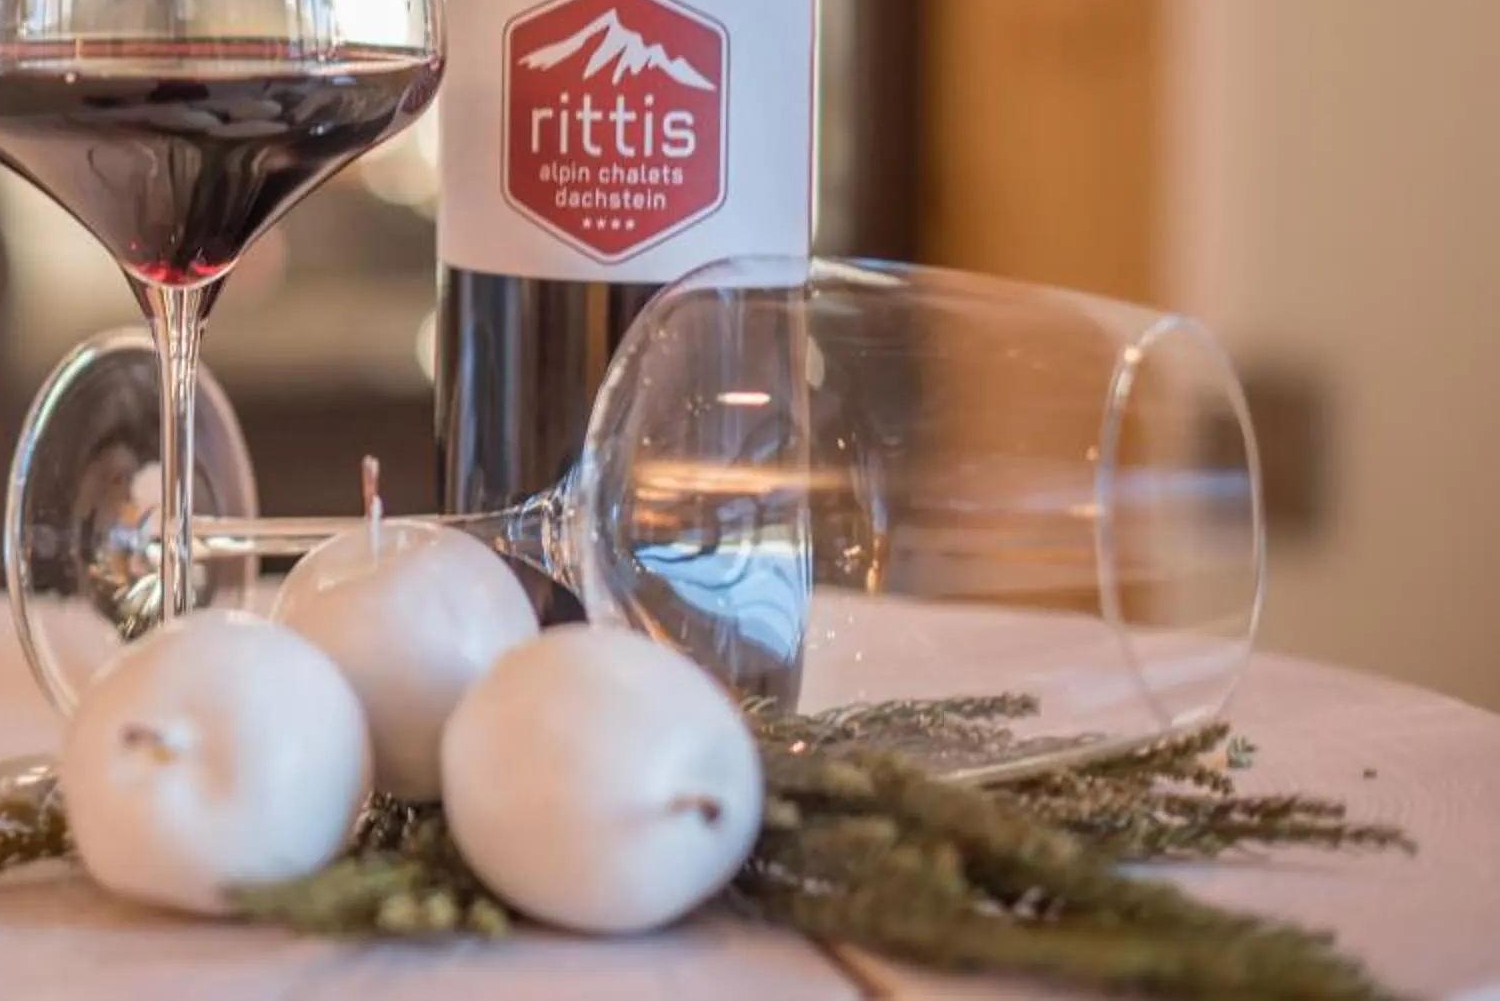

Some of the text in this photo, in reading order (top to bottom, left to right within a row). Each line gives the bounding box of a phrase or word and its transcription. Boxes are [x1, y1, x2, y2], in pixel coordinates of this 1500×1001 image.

[531, 92, 697, 157] rittis
[539, 162, 684, 186] alpin chalets
[555, 187, 667, 211] dachstein
